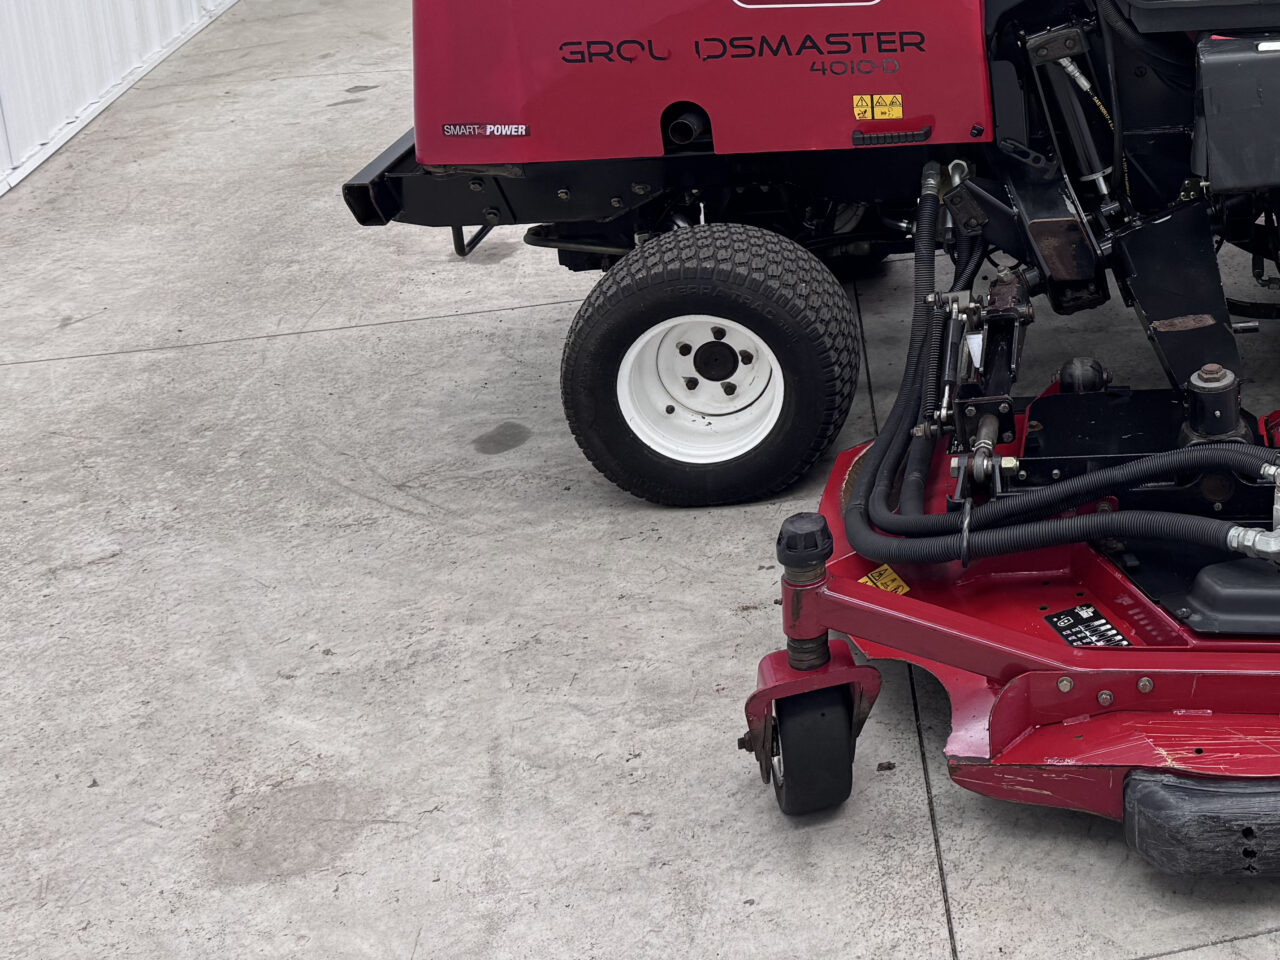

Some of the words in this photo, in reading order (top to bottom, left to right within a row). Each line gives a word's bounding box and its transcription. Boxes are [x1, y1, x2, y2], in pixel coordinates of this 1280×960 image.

[559, 31, 926, 64] GROUDSMASTER
[443, 124, 480, 136] SMART
[485, 124, 526, 136] POWER
